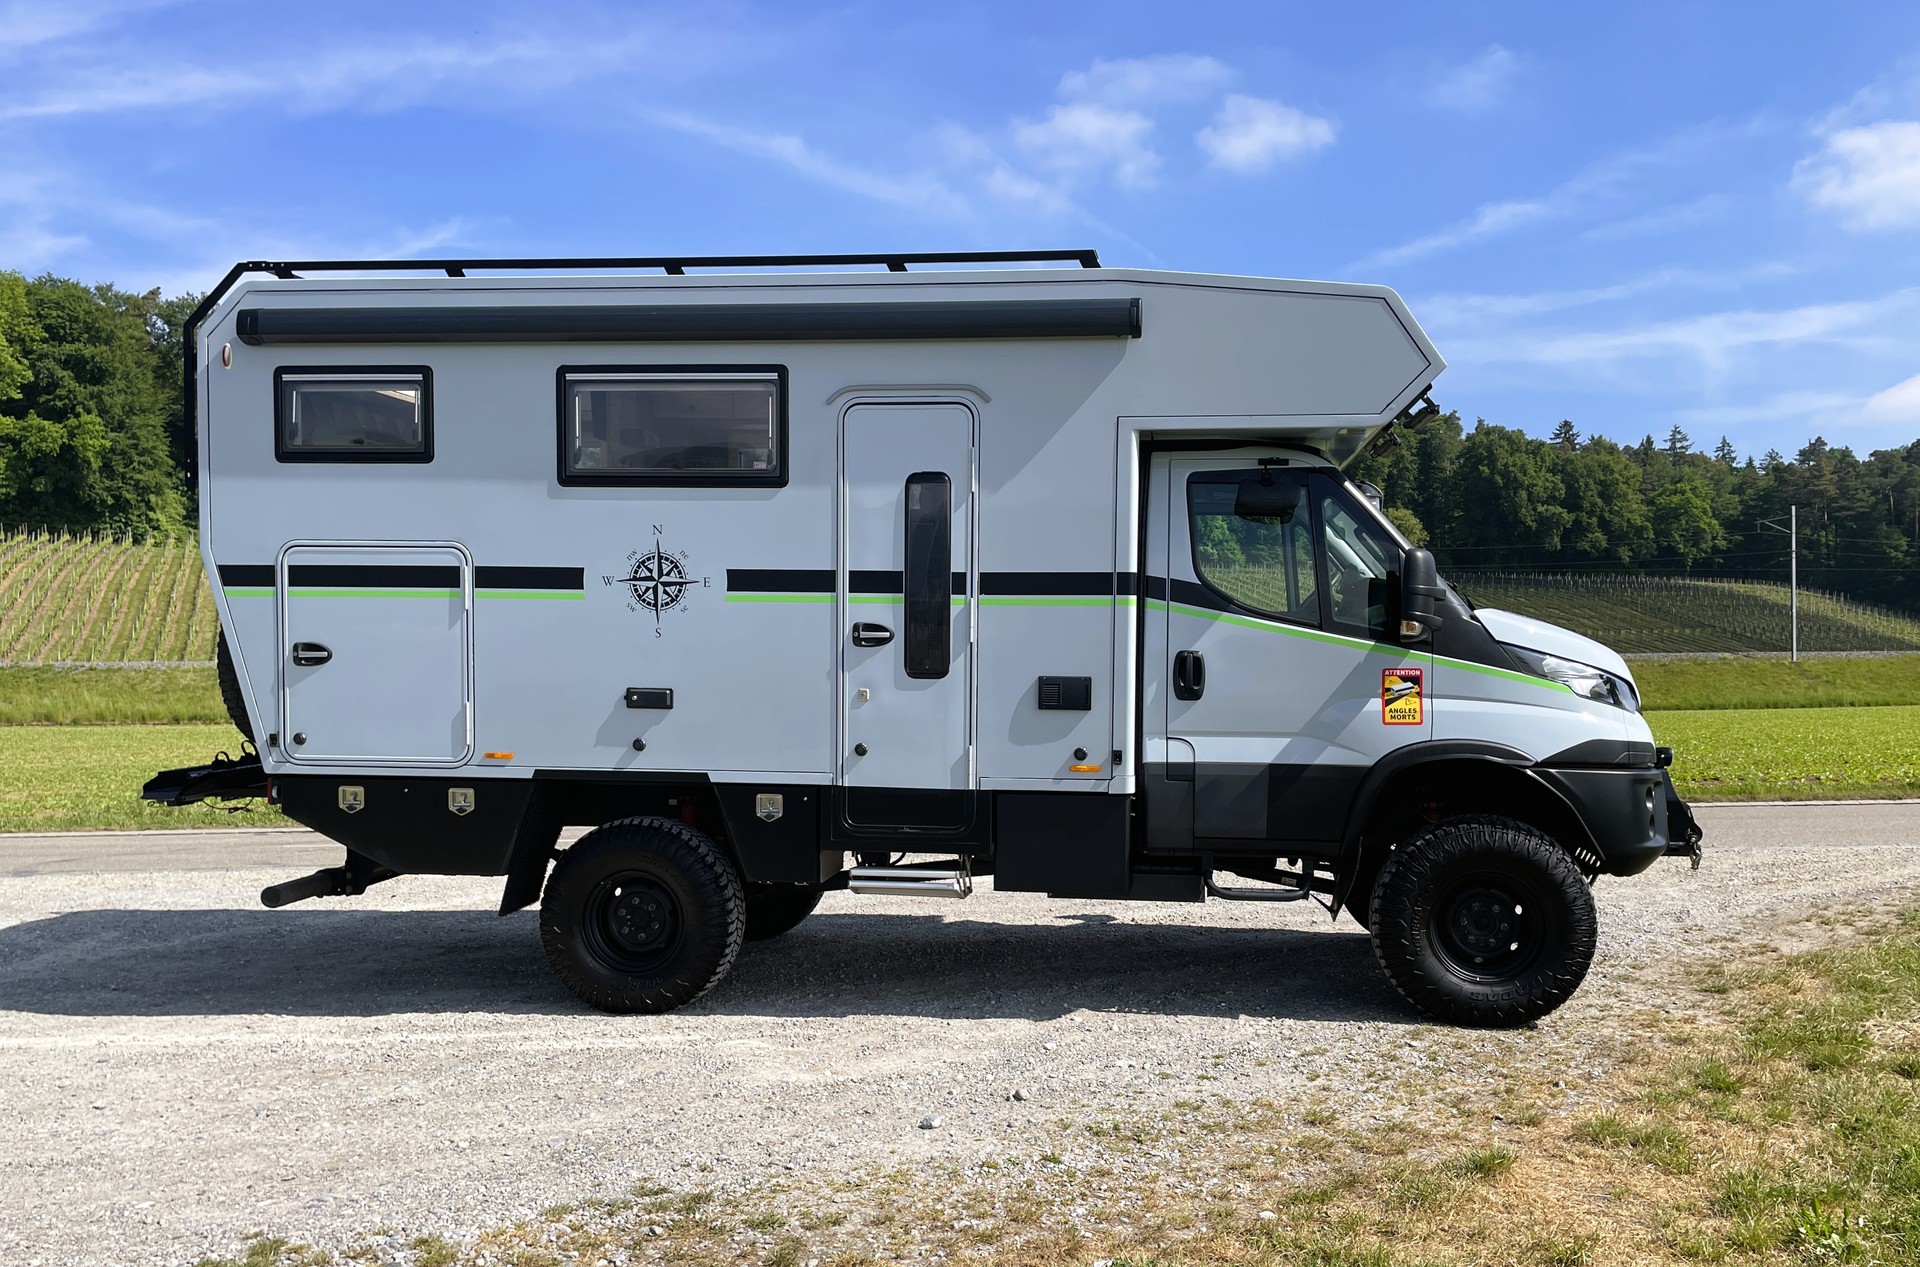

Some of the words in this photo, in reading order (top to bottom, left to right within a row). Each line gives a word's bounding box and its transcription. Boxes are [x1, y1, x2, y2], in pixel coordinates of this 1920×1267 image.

[652, 525, 663, 535] N
[626, 549, 638, 561] nw
[679, 550, 689, 560] ne
[602, 576, 615, 586] W
[704, 577, 711, 587] E
[626, 602, 637, 613] sw
[680, 605, 689, 614] se
[655, 628, 662, 638] S
